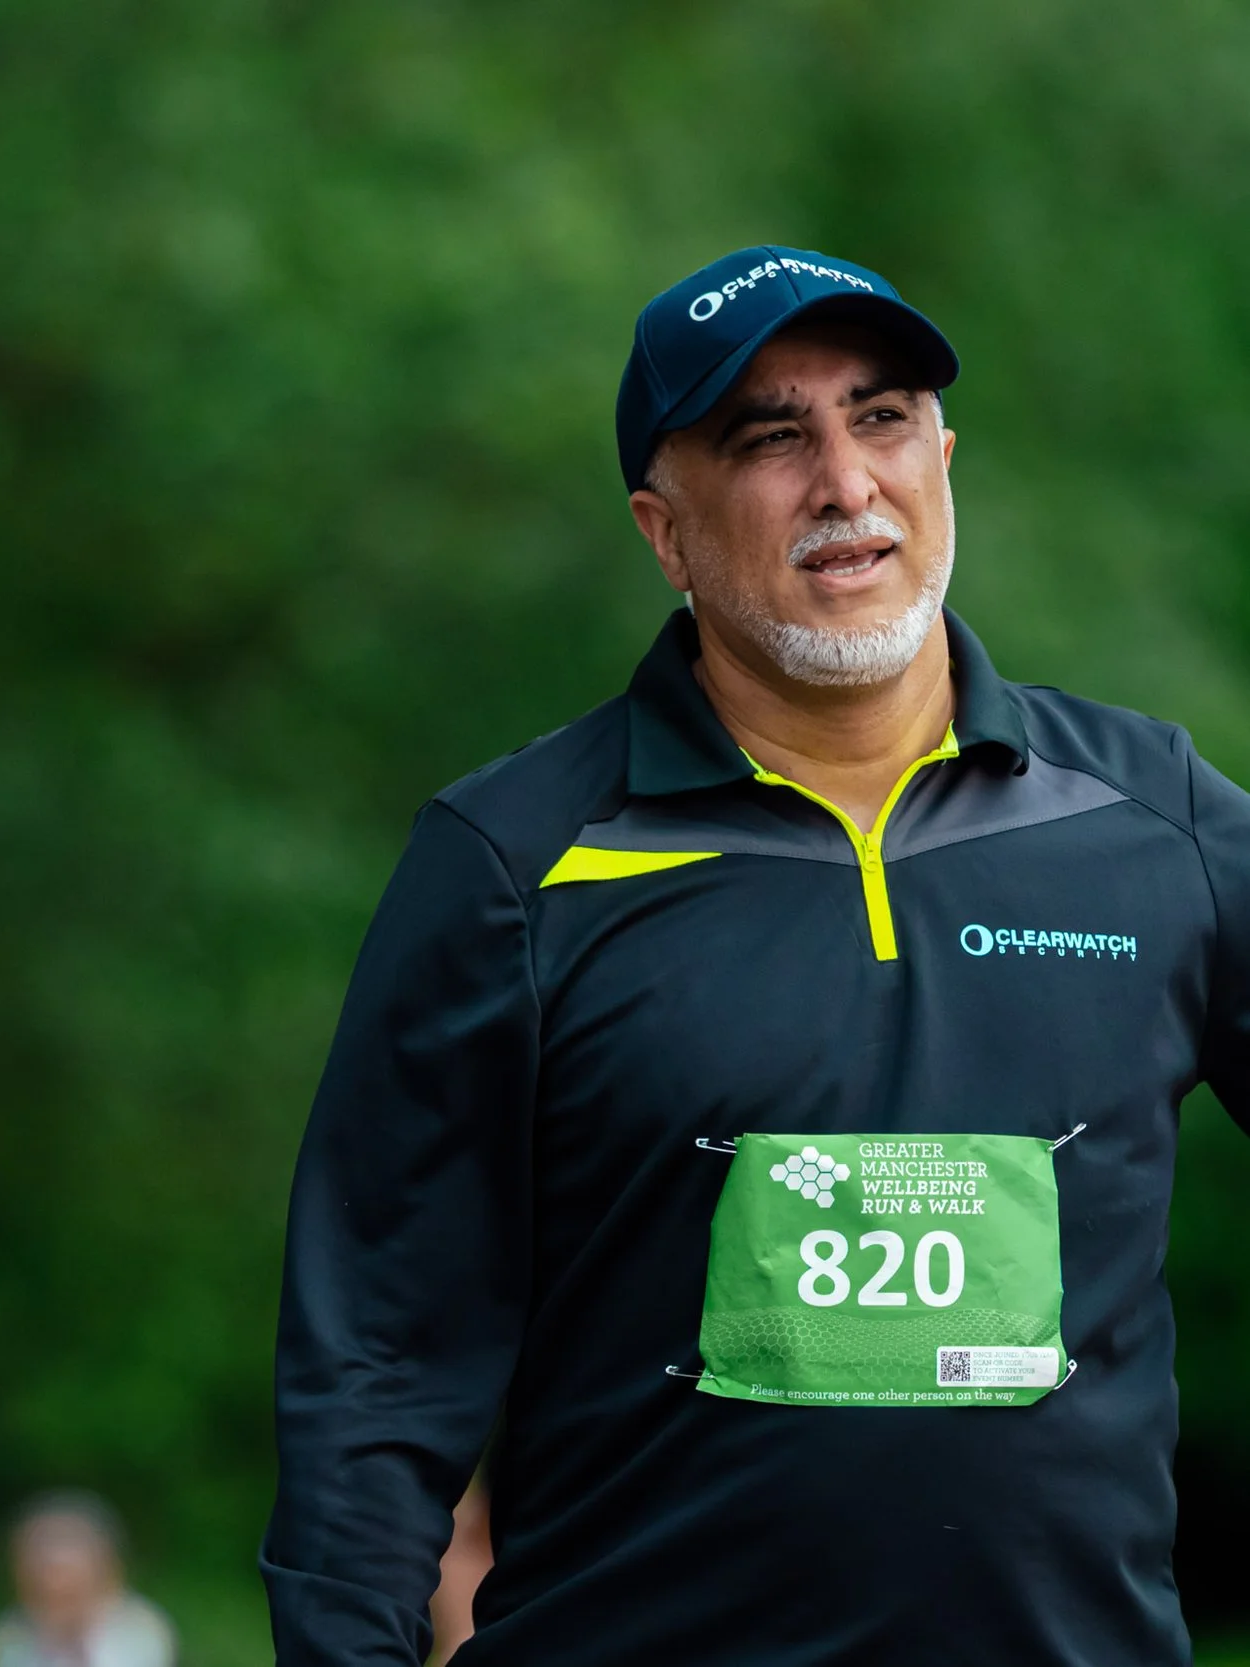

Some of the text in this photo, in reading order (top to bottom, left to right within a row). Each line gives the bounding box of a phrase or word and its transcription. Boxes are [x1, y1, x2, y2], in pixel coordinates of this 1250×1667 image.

[722, 258, 874, 292] CLEARWATCH
[995, 929, 1137, 953] CLEARWATCH
[998, 946, 1137, 962] SECURITY
[859, 1142, 945, 1158] GREATER
[860, 1161, 988, 1178] MANCHESTER
[861, 1180, 976, 1196] WELLBEING
[861, 1199, 986, 1215] RUN & WALK
[797, 1229, 965, 1308] 820
[750, 1384, 1016, 1403] Please encourage one other person on the way
